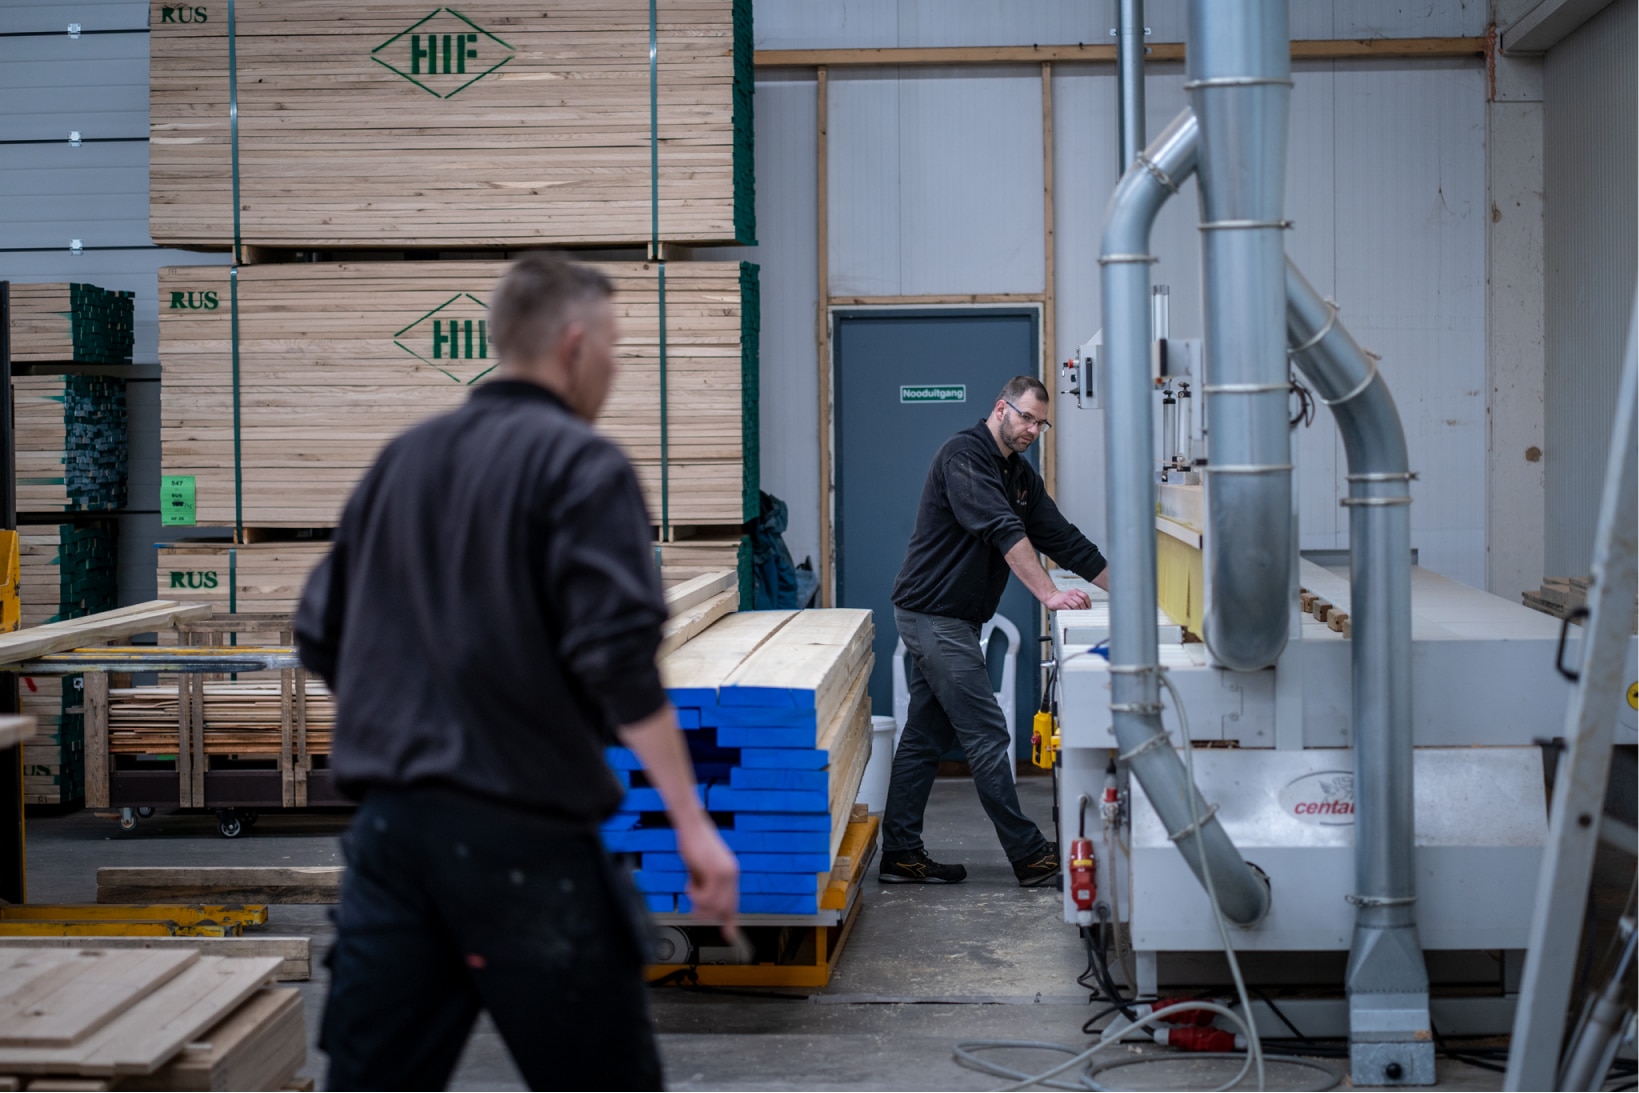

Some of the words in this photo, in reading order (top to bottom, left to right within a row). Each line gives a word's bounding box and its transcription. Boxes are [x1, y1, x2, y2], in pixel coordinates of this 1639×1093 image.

[161, 6, 208, 24] RUS
[411, 34, 478, 75] HIF
[169, 290, 219, 310] RUS
[903, 388, 963, 400] Nooduitgang
[169, 570, 219, 589] RUS
